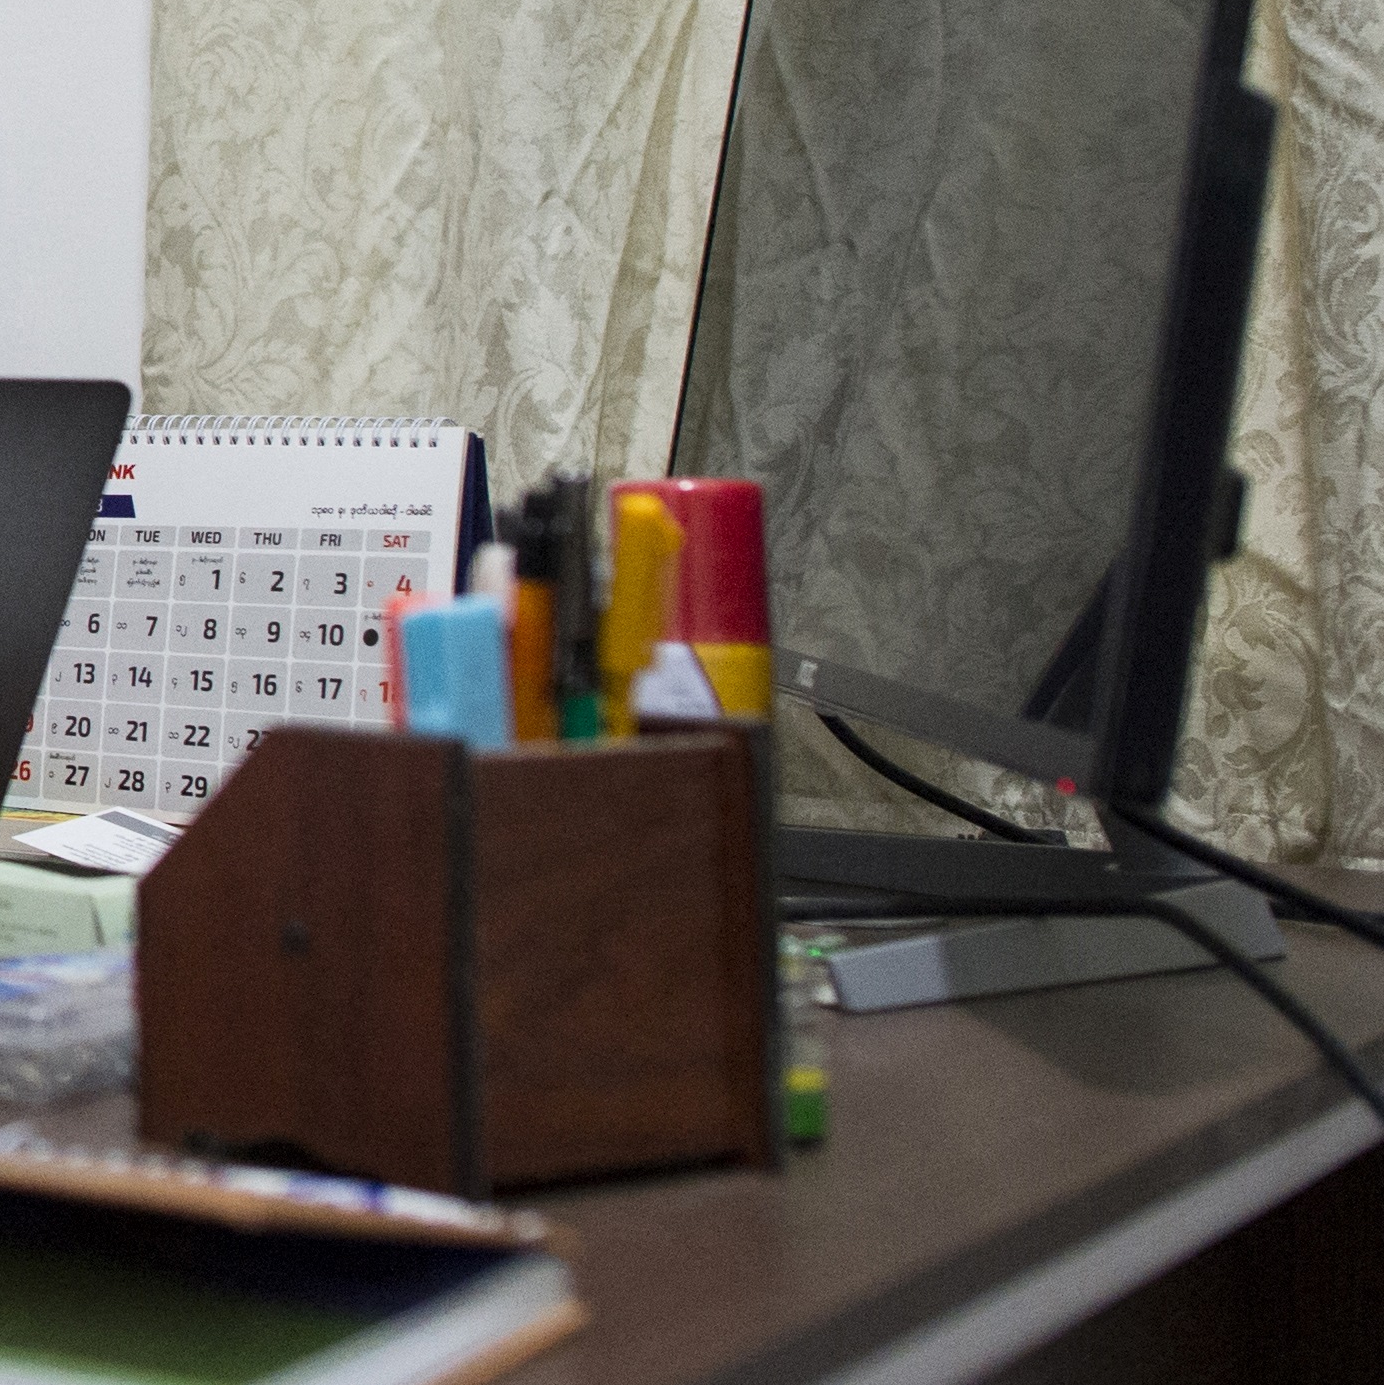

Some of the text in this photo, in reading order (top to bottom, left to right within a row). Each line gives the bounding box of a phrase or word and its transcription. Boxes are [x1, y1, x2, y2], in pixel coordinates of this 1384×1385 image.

[107, 463, 136, 480] NK
[87, 529, 410, 548] ON TUE WED THU FRI SAT
[211, 569, 412, 596] 1 2 3 4
[88, 613, 344, 647] 6 7 8 9 10
[73, 662, 96, 684] 13
[128, 666, 153, 688] 14
[189, 669, 214, 692] 15
[252, 673, 277, 696] 16
[317, 677, 343, 700] 17
[64, 715, 91, 738] 20
[125, 720, 147, 742] 21
[183, 724, 211, 747] 22
[64, 764, 90, 786] 27
[117, 769, 145, 792] 28
[180, 774, 208, 798] 29
